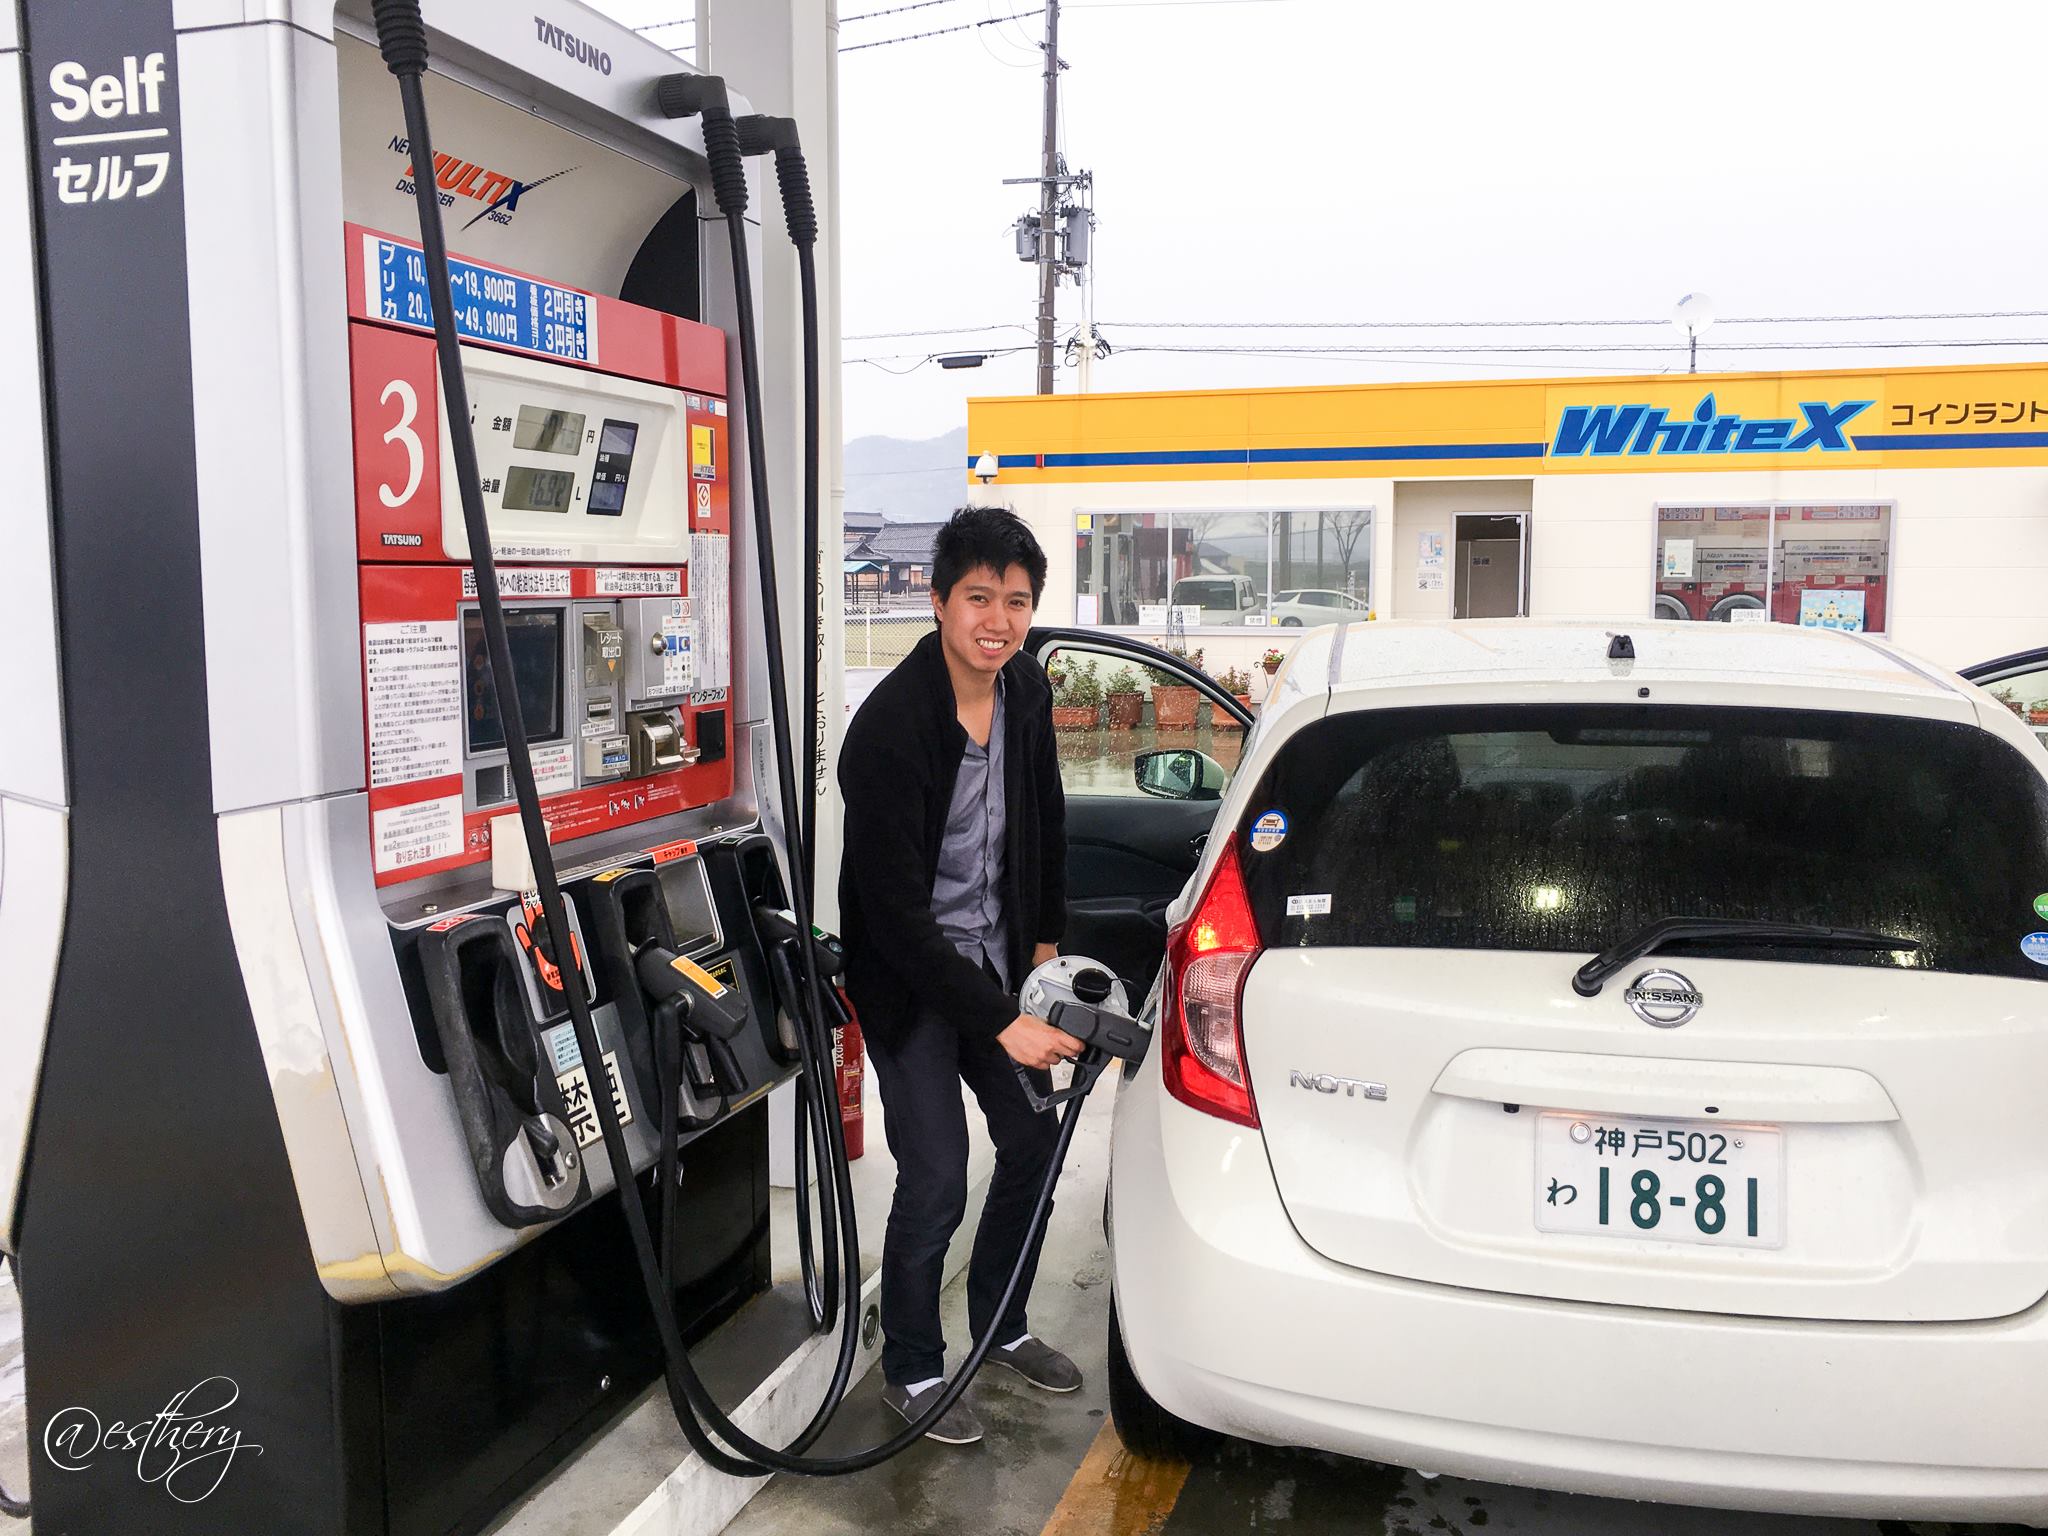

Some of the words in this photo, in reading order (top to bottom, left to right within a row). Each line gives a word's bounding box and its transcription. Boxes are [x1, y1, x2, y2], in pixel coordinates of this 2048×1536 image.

[534, 16, 612, 77] TATSUNO
[49, 52, 165, 122] Self
[388, 135, 410, 157] NE
[52, 151, 170, 204] セルフ
[488, 211, 513, 226] 3662
[381, 244, 398, 320] プリカ
[406, 255, 516, 309] 10,～19,900円
[408, 292, 517, 342] 20,～49,900円
[543, 288, 584, 326] 2円引き
[545, 323, 585, 359] 3円引き
[492, 416, 512, 432] 金額
[1551, 391, 1877, 457] WhiteX
[378, 379, 424, 507] 3
[576, 486, 581, 501] L
[382, 534, 422, 546] TATSUNO
[400, 624, 427, 635] ご注意
[600, 633, 623, 645] レシート
[602, 646, 621, 658] 取出口
[691, 688, 726, 702] インターフォン
[1634, 991, 1695, 1003] NISSAN
[1289, 1069, 1388, 1101] NOTE
[1547, 1176, 1577, 1206] わ
[1599, 1166, 1758, 1237] 18-81
